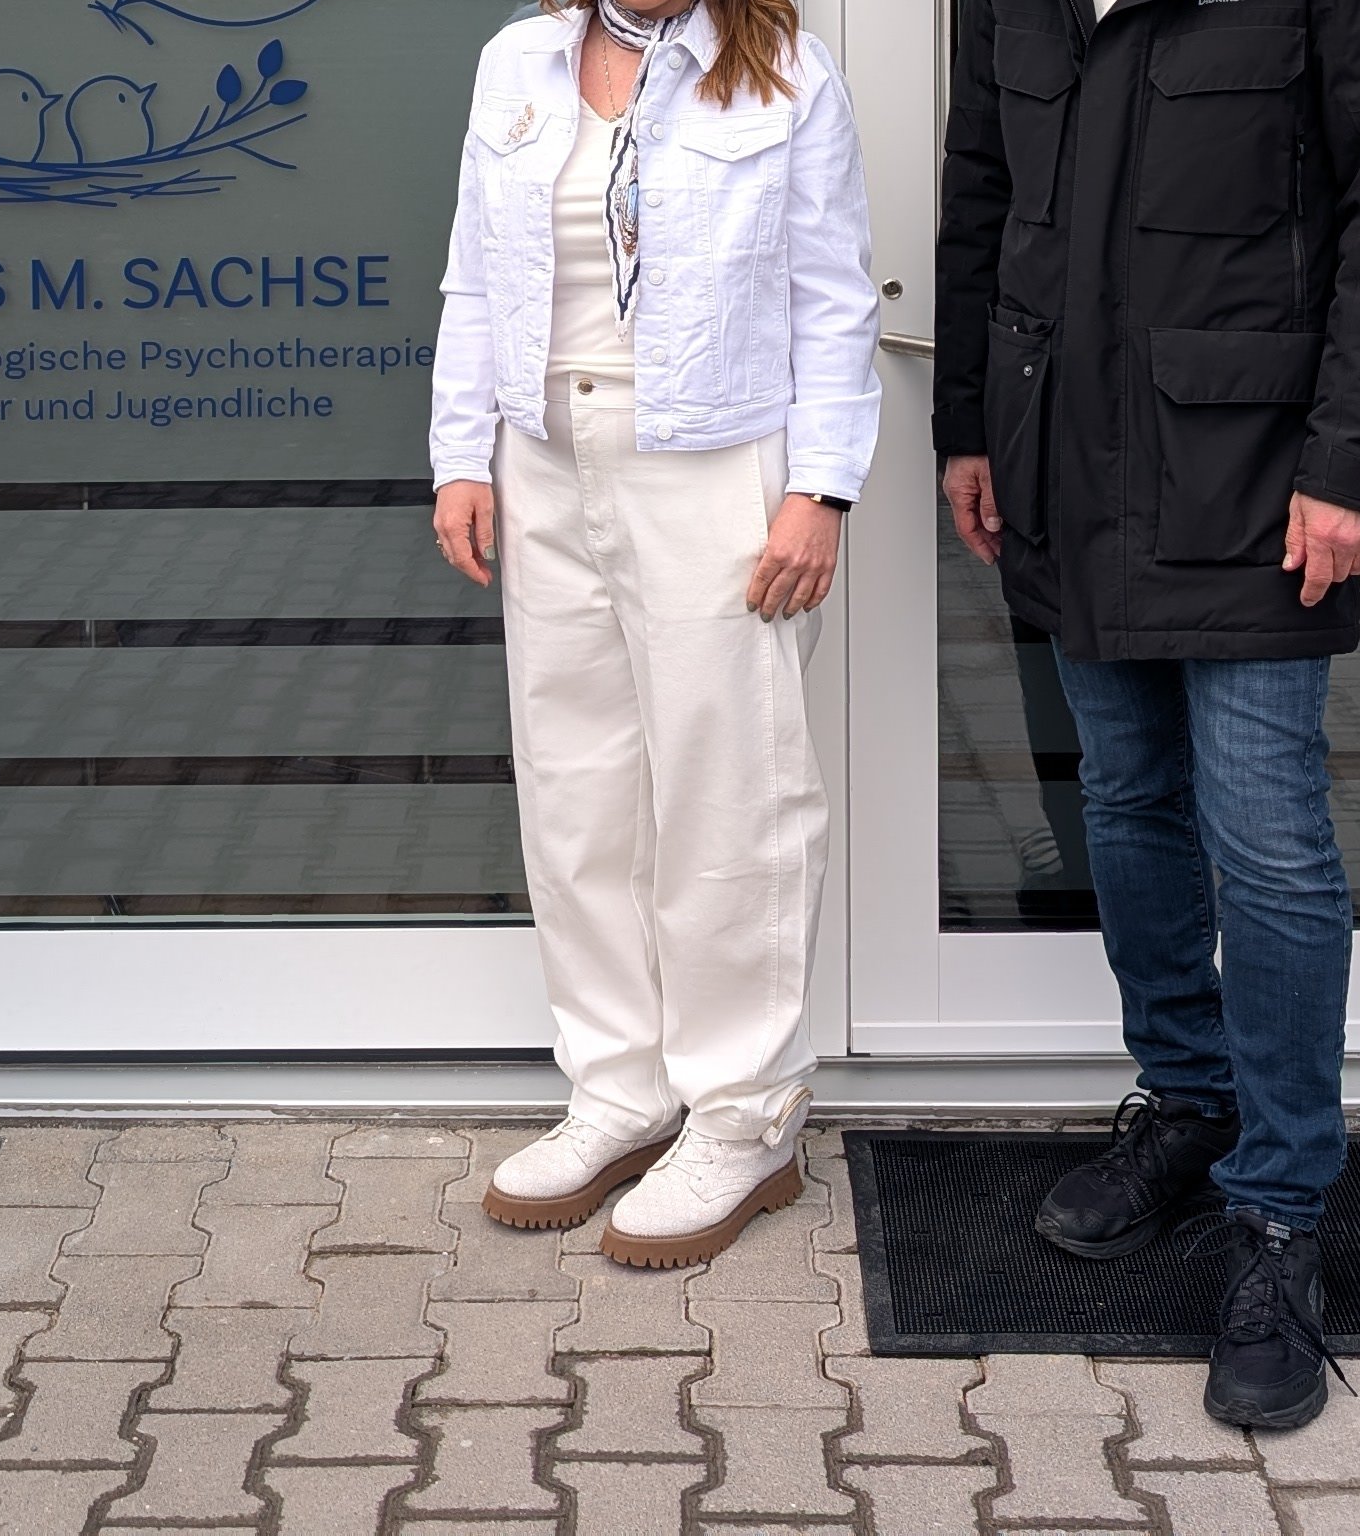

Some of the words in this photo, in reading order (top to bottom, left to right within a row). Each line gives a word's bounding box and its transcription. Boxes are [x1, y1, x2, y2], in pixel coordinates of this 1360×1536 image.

[31, 258, 105, 312] M.
[122, 254, 390, 311] SACHSE
[140, 337, 435, 376] Psychotherapie
[24, 389, 94, 421] und
[106, 386, 333, 427] Jugendliche
